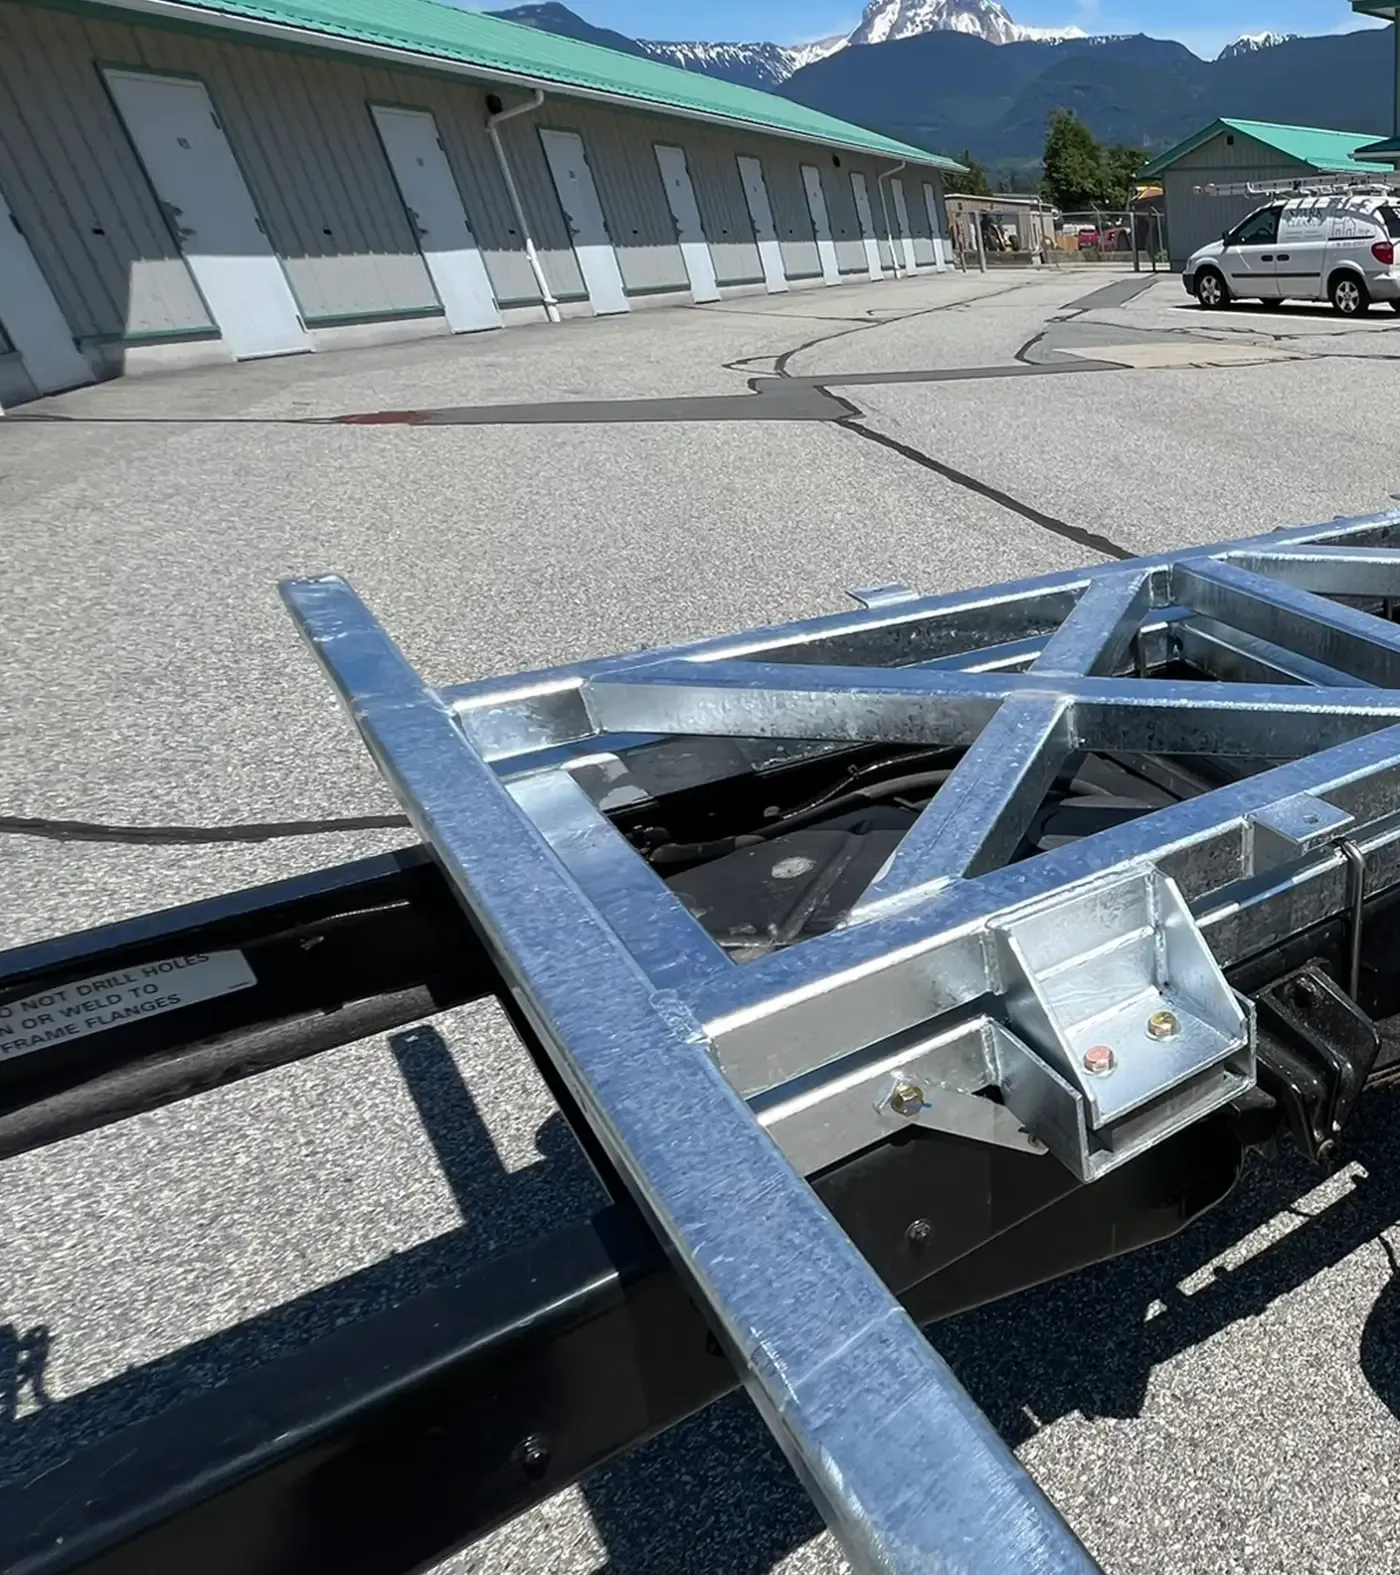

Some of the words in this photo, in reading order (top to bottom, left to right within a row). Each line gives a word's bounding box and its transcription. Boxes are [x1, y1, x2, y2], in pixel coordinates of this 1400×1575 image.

[0, 1006, 13, 1018] O
[20, 990, 67, 1012] NOT
[76, 974, 137, 996] DRILL
[141, 953, 210, 978] HOLES
[0, 1024, 14, 1037] N
[21, 1013, 54, 1030] OR
[59, 994, 123, 1018] WELD
[128, 983, 159, 999] TO
[0, 1023, 81, 1054] FRAME
[84, 993, 181, 1028] FLANGES
